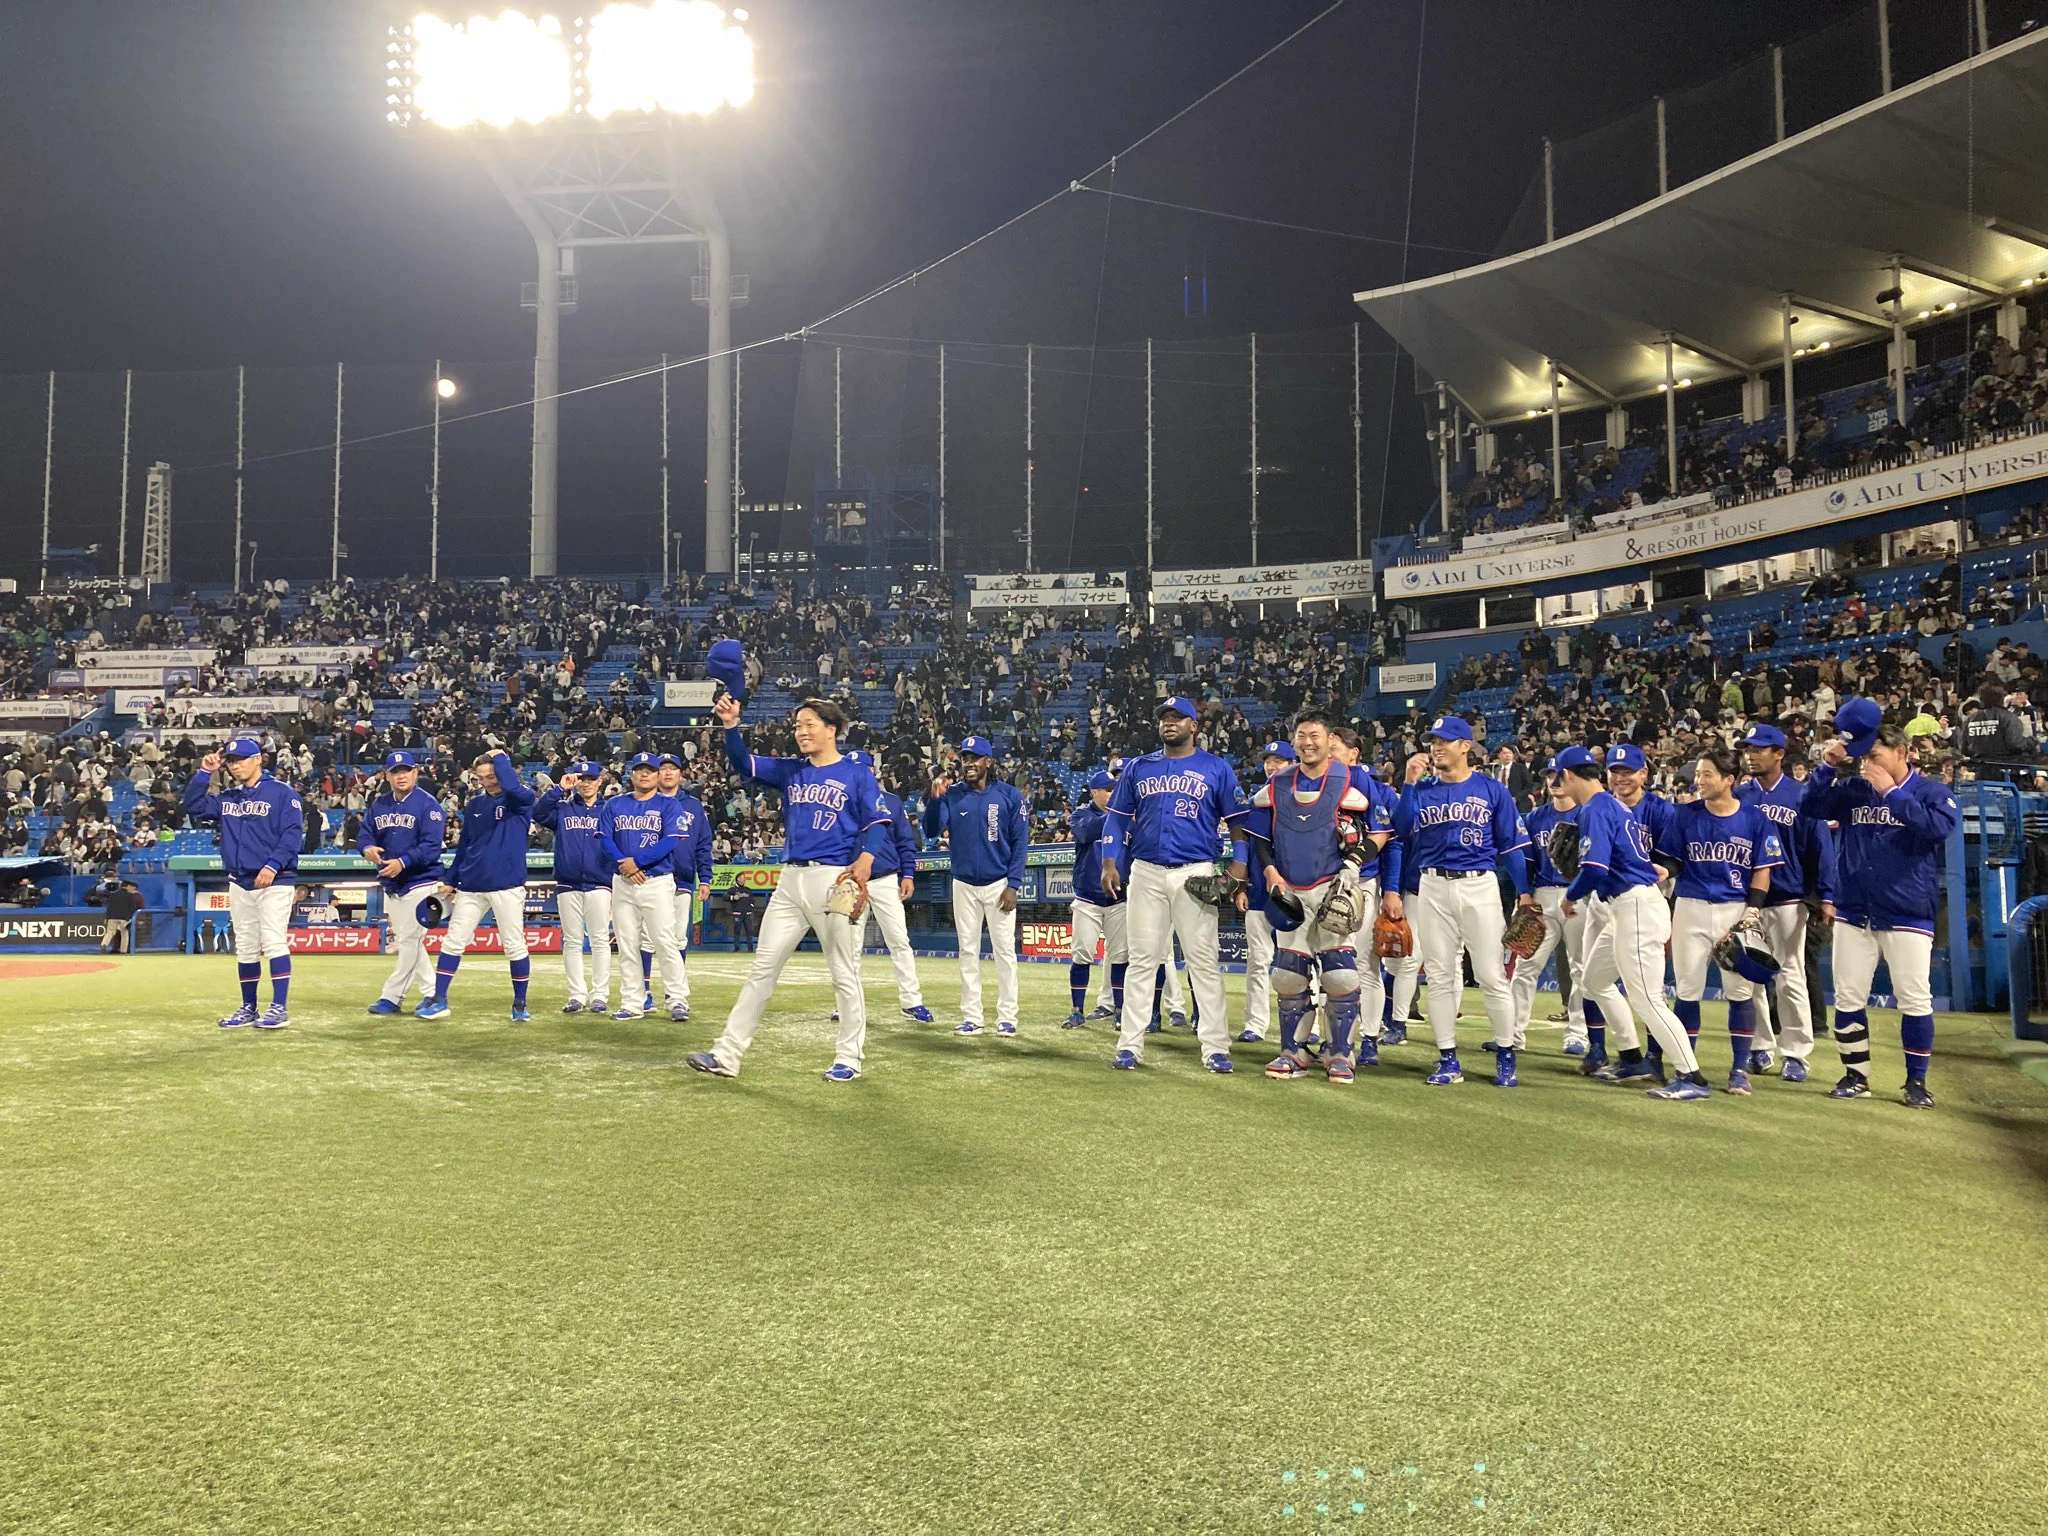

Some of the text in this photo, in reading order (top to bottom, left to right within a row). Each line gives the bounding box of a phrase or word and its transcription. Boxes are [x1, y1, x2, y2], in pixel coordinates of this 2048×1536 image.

[1867, 409, 1888, 420] YKK
[1868, 417, 1888, 433] ap
[1647, 532, 1706, 556] RESORT
[1714, 518, 1768, 542] HOUSE
[1332, 564, 1370, 576] マイナビ
[68, 579, 127, 590] ジャックロード
[1184, 574, 1221, 584] マイナビ
[1327, 578, 1367, 591] マイナビ
[1079, 592, 1116, 603] マイナビ
[1254, 584, 1293, 596] マイナビ
[1002, 594, 1038, 604] マイナビ
[1968, 726, 1998, 737] STAFF
[1136, 774, 1209, 800] DRAGONS
[1174, 798, 1200, 819] 23
[1417, 802, 1492, 829] DRAGONS
[613, 815, 662, 832] DRAGONS
[812, 810, 837, 831] 17
[639, 832, 659, 848] 79
[1460, 828, 1484, 846] 63
[1730, 869, 1744, 889] 2
[0, 921, 107, 938] U-NEXT HOLD
[1022, 925, 1073, 946] ヨドバシ
[287, 931, 373, 948] スーパードライ
